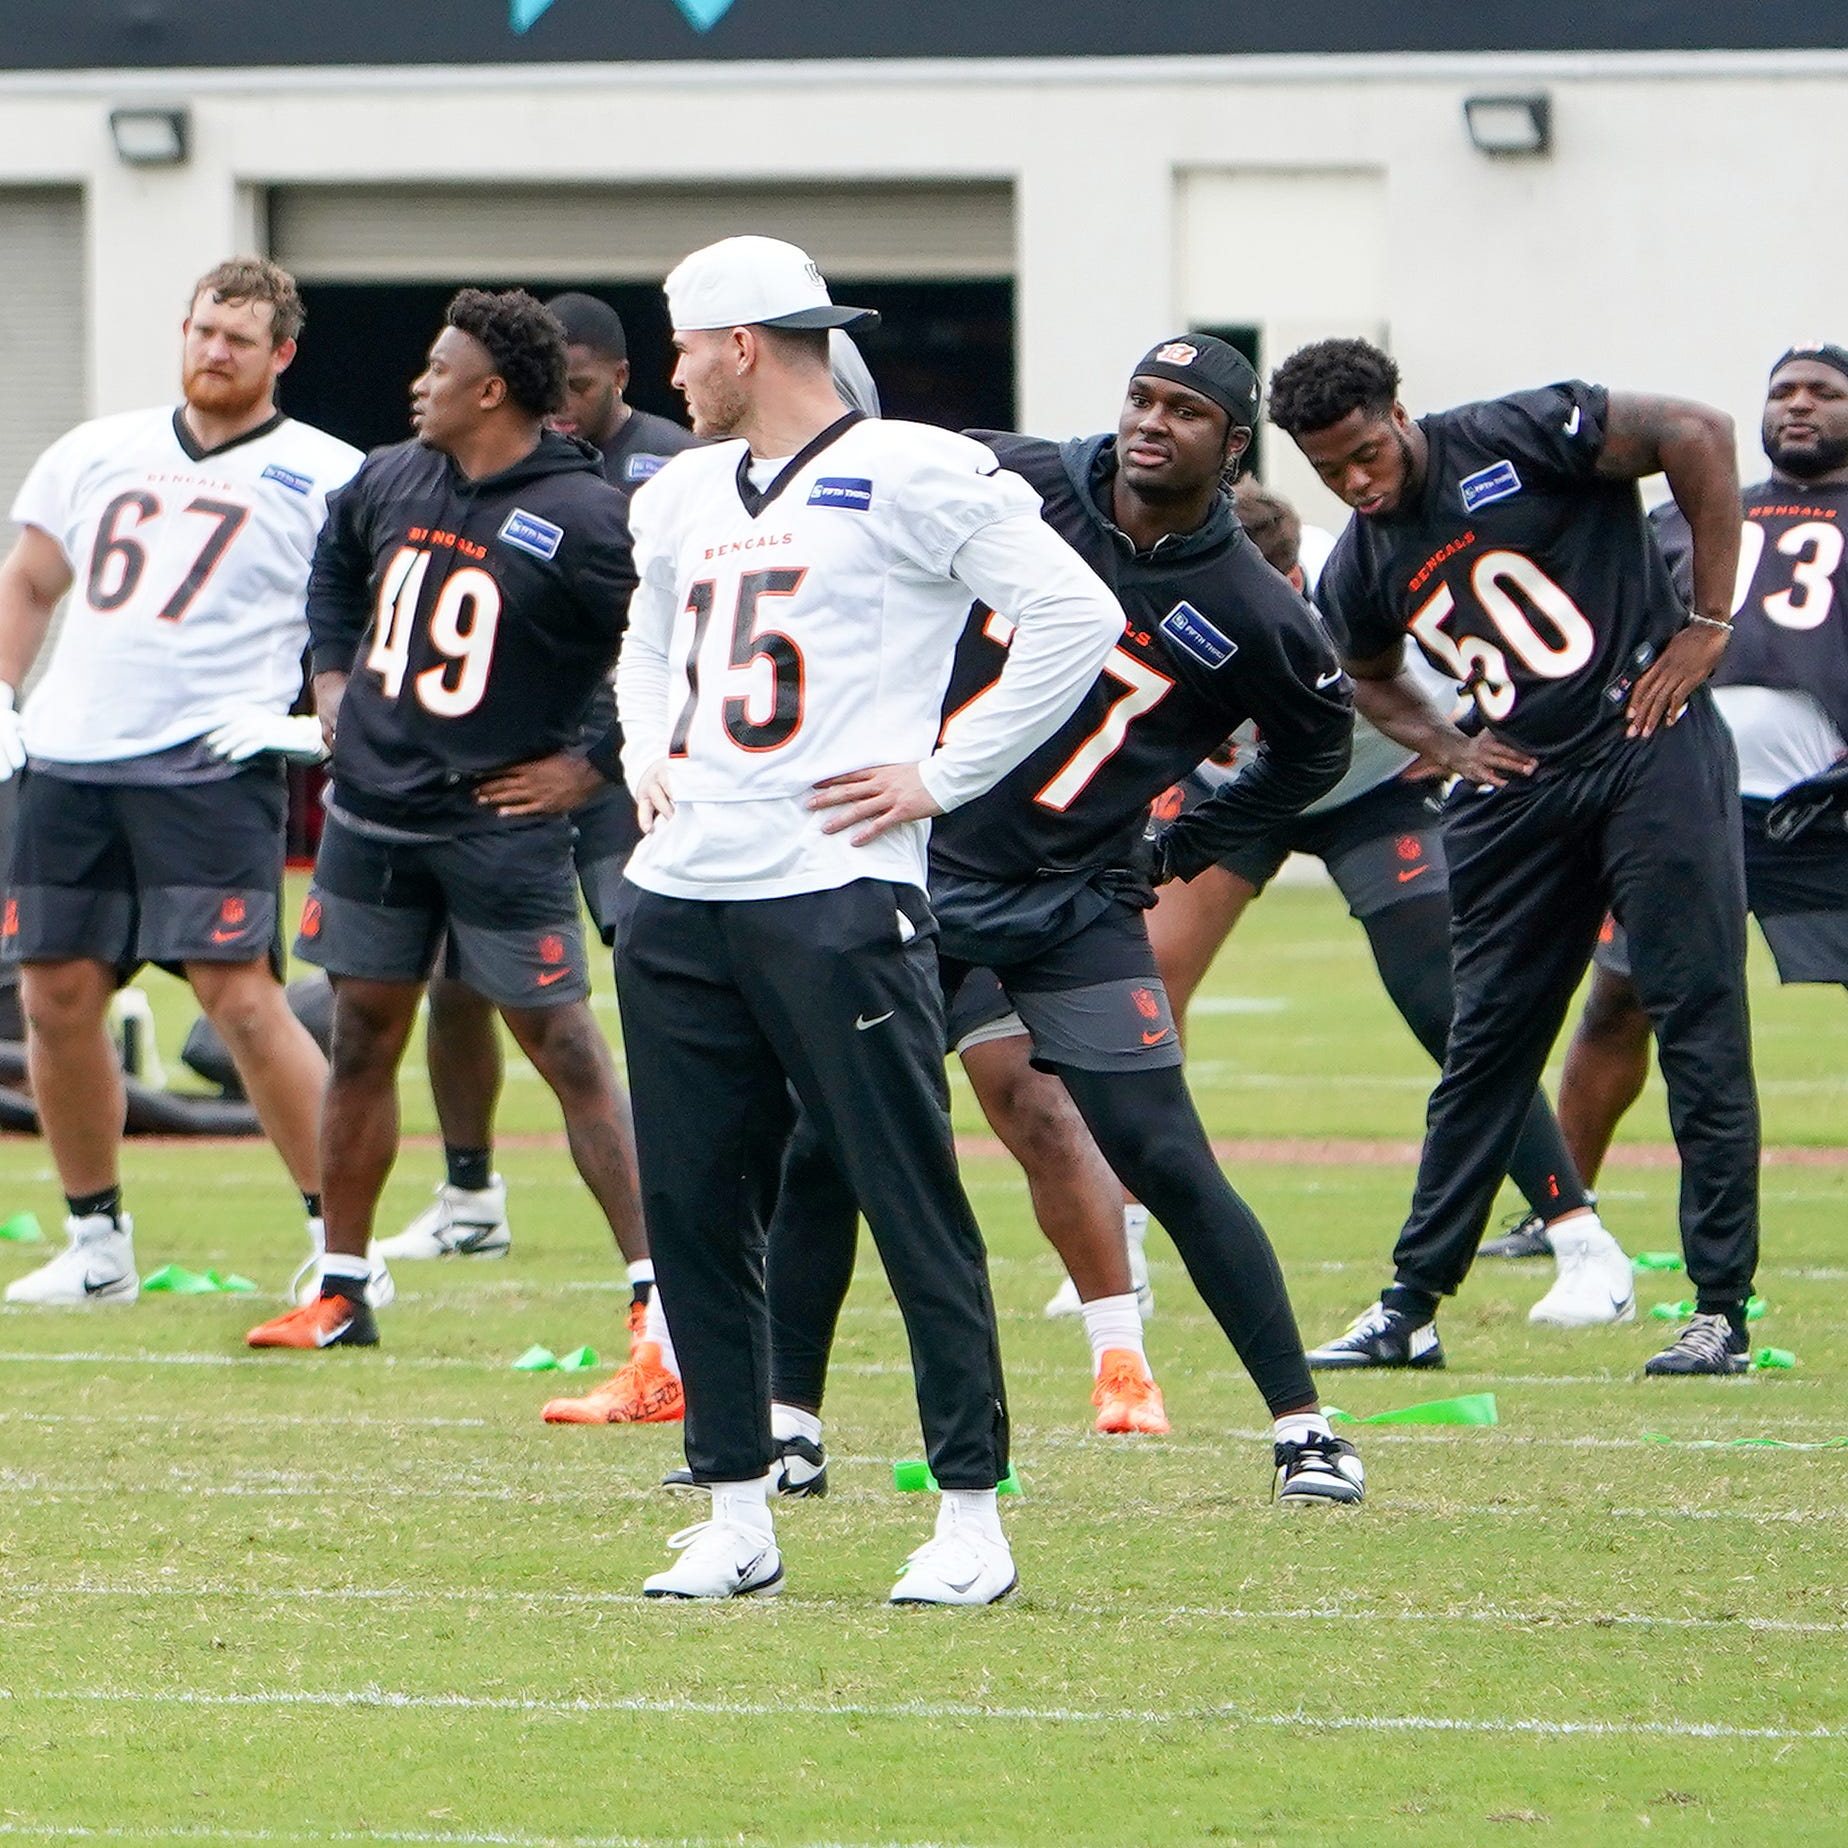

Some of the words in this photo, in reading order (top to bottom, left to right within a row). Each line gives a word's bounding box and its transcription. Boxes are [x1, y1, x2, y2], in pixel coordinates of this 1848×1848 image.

[85, 488, 252, 624] 67
[703, 532, 794, 561] BENGALS
[1408, 529, 1477, 593] BENGALS
[365, 544, 504, 718] 49
[668, 566, 811, 759] 15
[1406, 549, 1596, 722] 50
